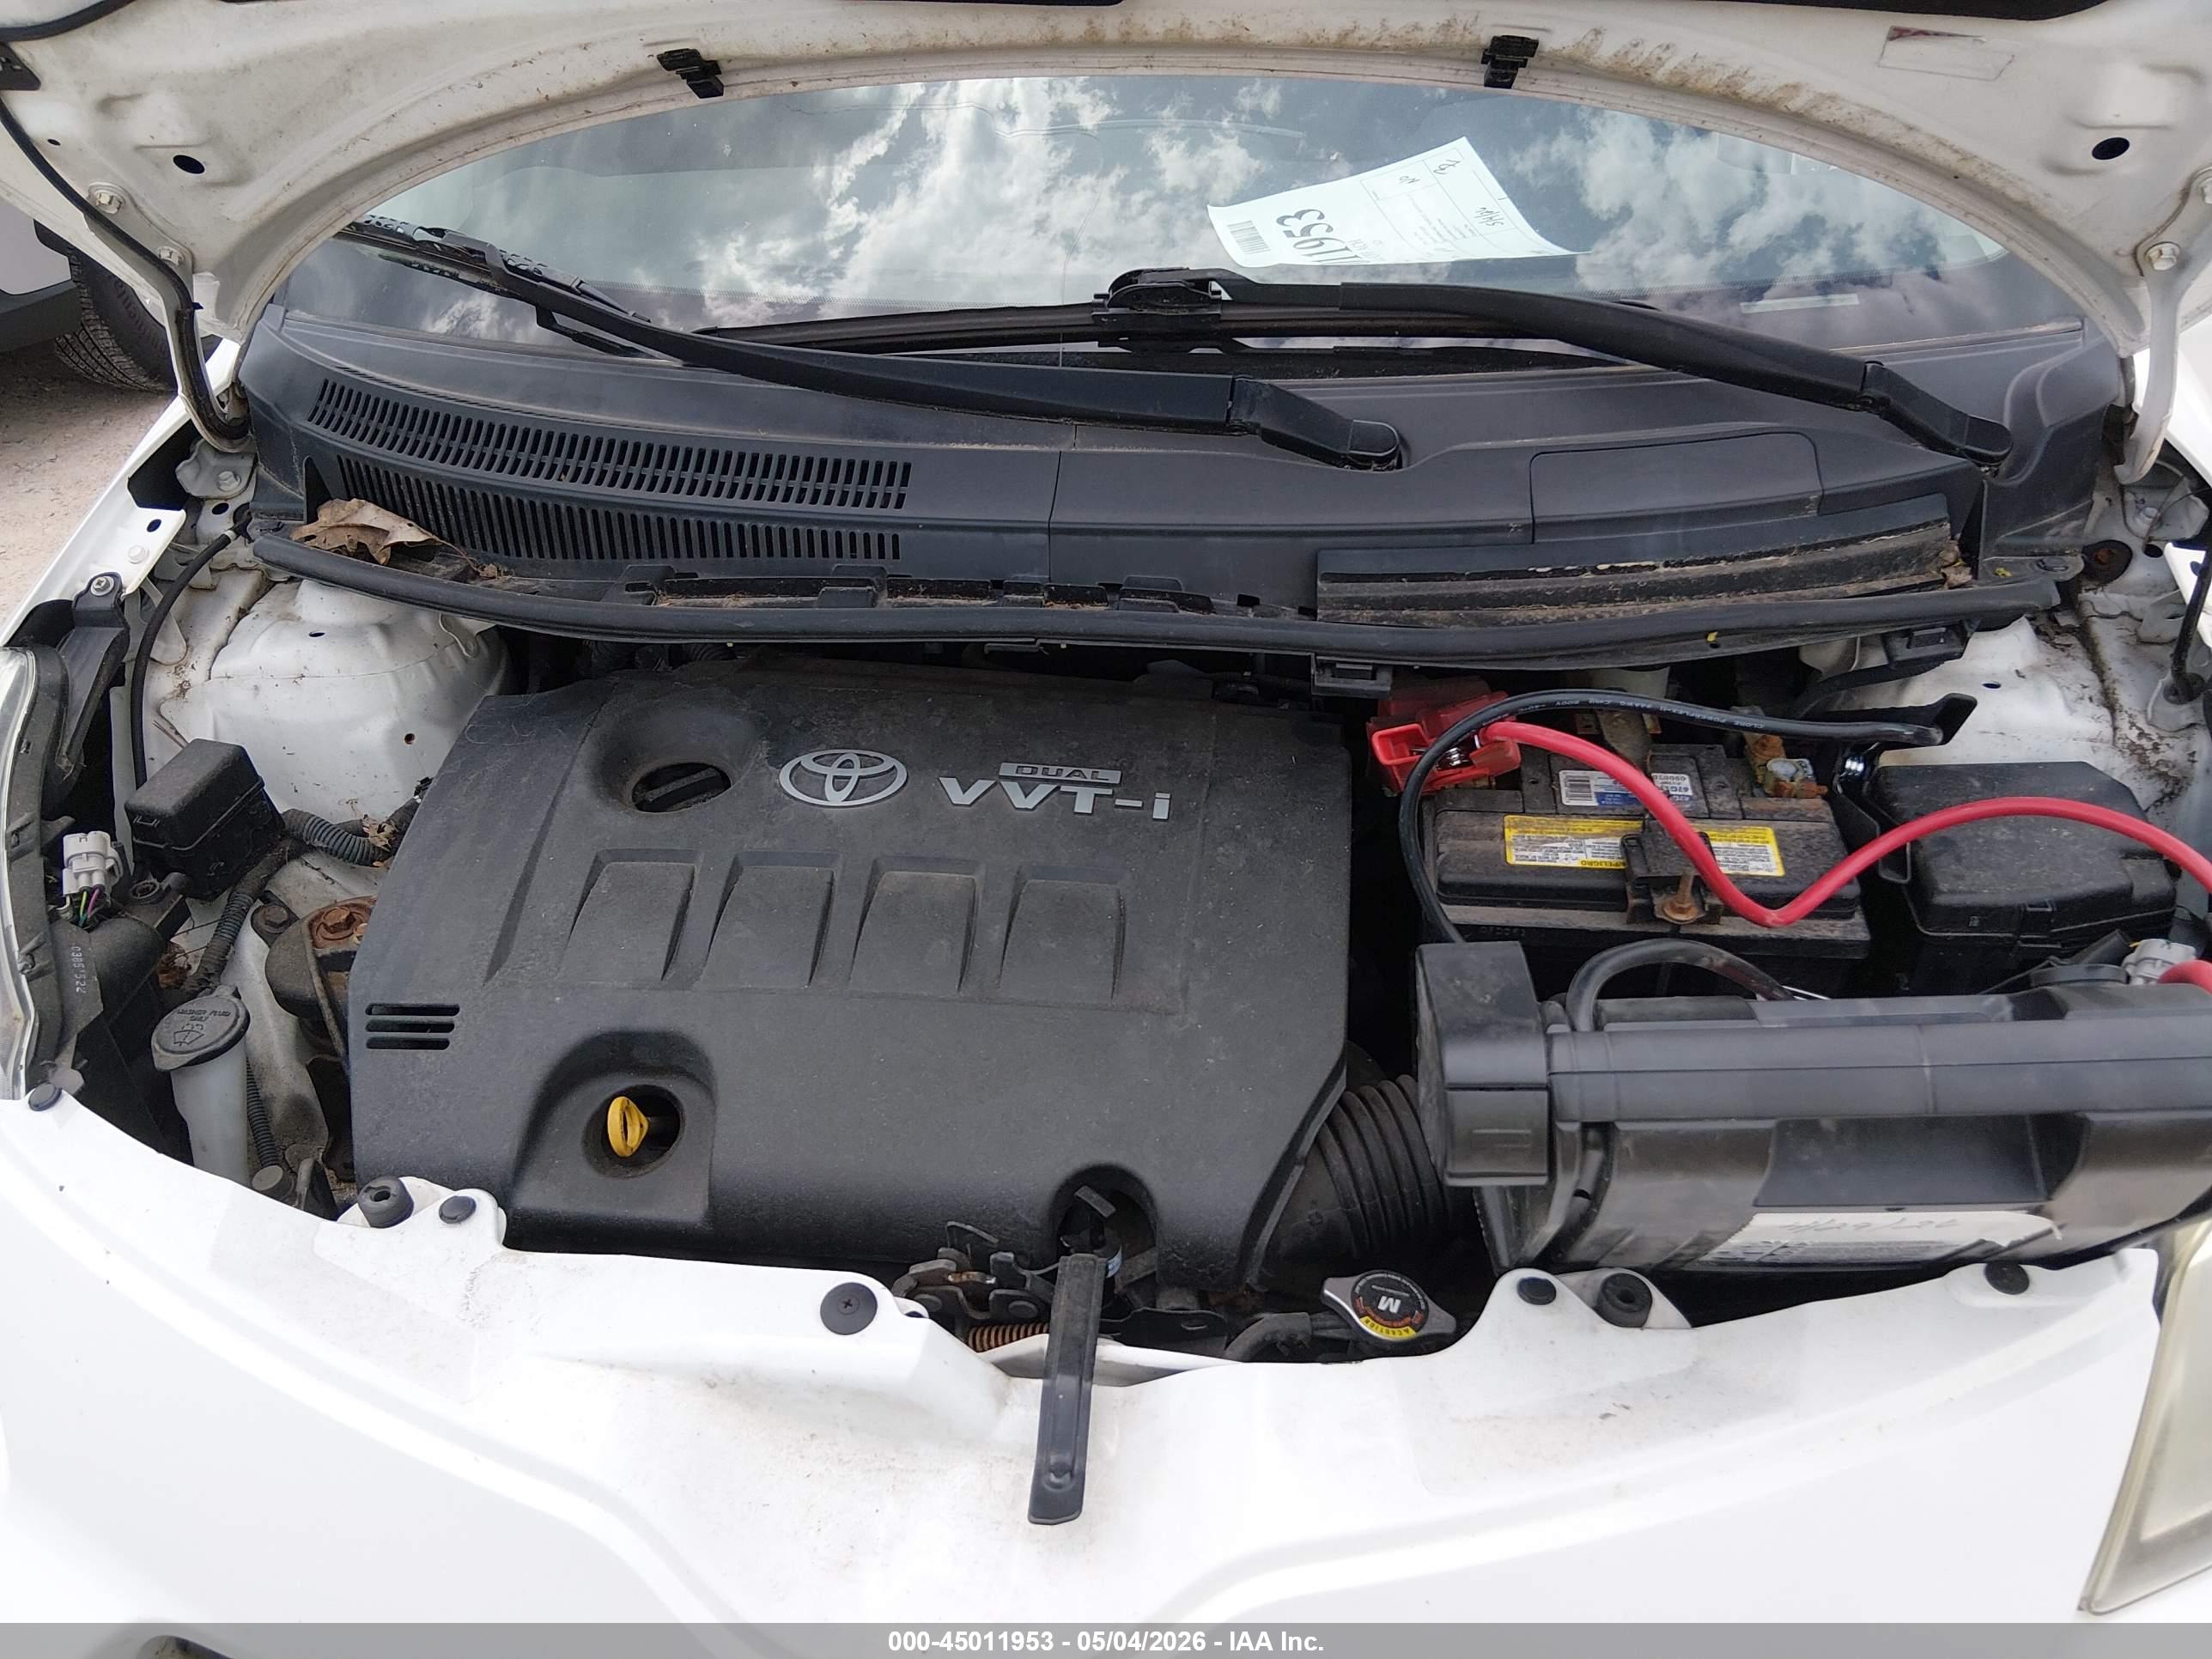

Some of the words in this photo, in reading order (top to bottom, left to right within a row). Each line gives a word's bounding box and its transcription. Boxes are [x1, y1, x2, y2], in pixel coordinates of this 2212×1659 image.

[1015, 764, 1109, 781] DUAL
[939, 776, 1171, 820] VVT-i
[1364, 1317, 1403, 1337] CAUTION
